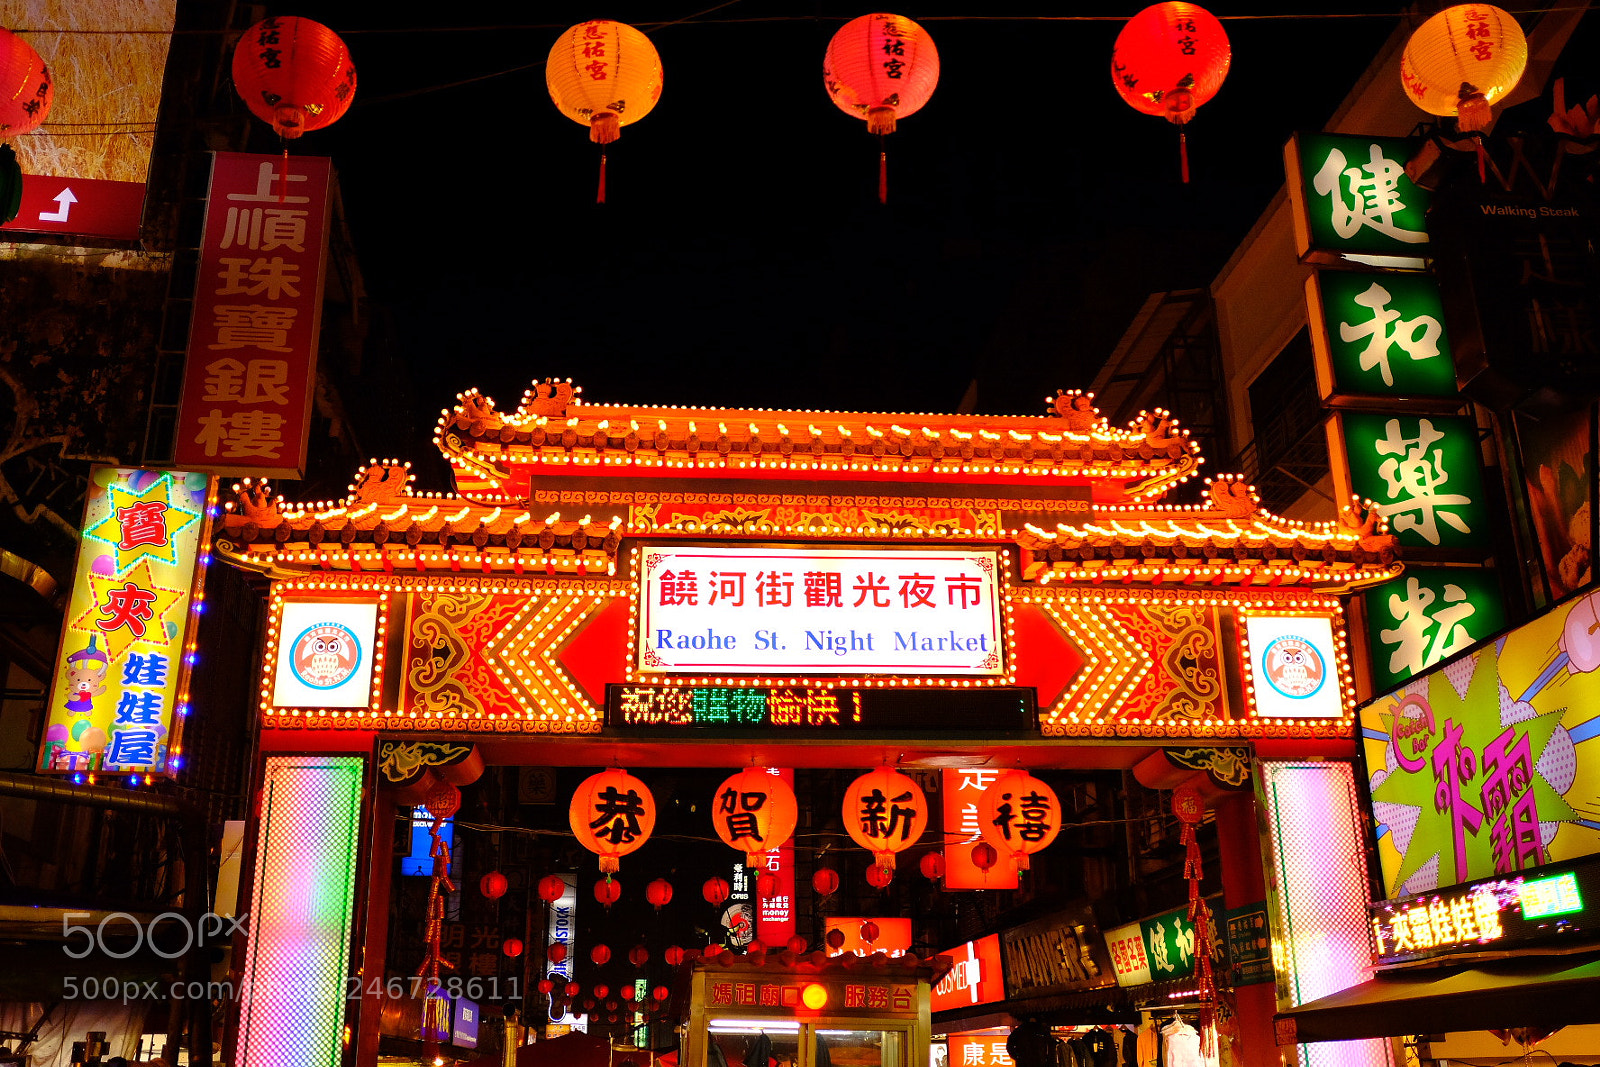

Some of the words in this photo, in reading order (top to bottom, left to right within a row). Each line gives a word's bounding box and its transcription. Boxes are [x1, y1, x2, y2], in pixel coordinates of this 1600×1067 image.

[1480, 204, 1537, 220] Walking
[1538, 205, 1580, 217] Steak
[194, 162, 310, 459] 上順珠寶銀樓
[658, 569, 983, 610] 饒河街觀光夜市
[656, 628, 736, 651] Raohe
[754, 629, 786, 651] St.
[804, 629, 875, 656] Night
[894, 630, 988, 652] Market
[109, 653, 168, 766] 娃娃屋
[1397, 713, 1429, 739] Catch
[1412, 734, 1430, 755] Bar
[762, 909, 789, 917] money
[844, 984, 913, 1010] 服務台
